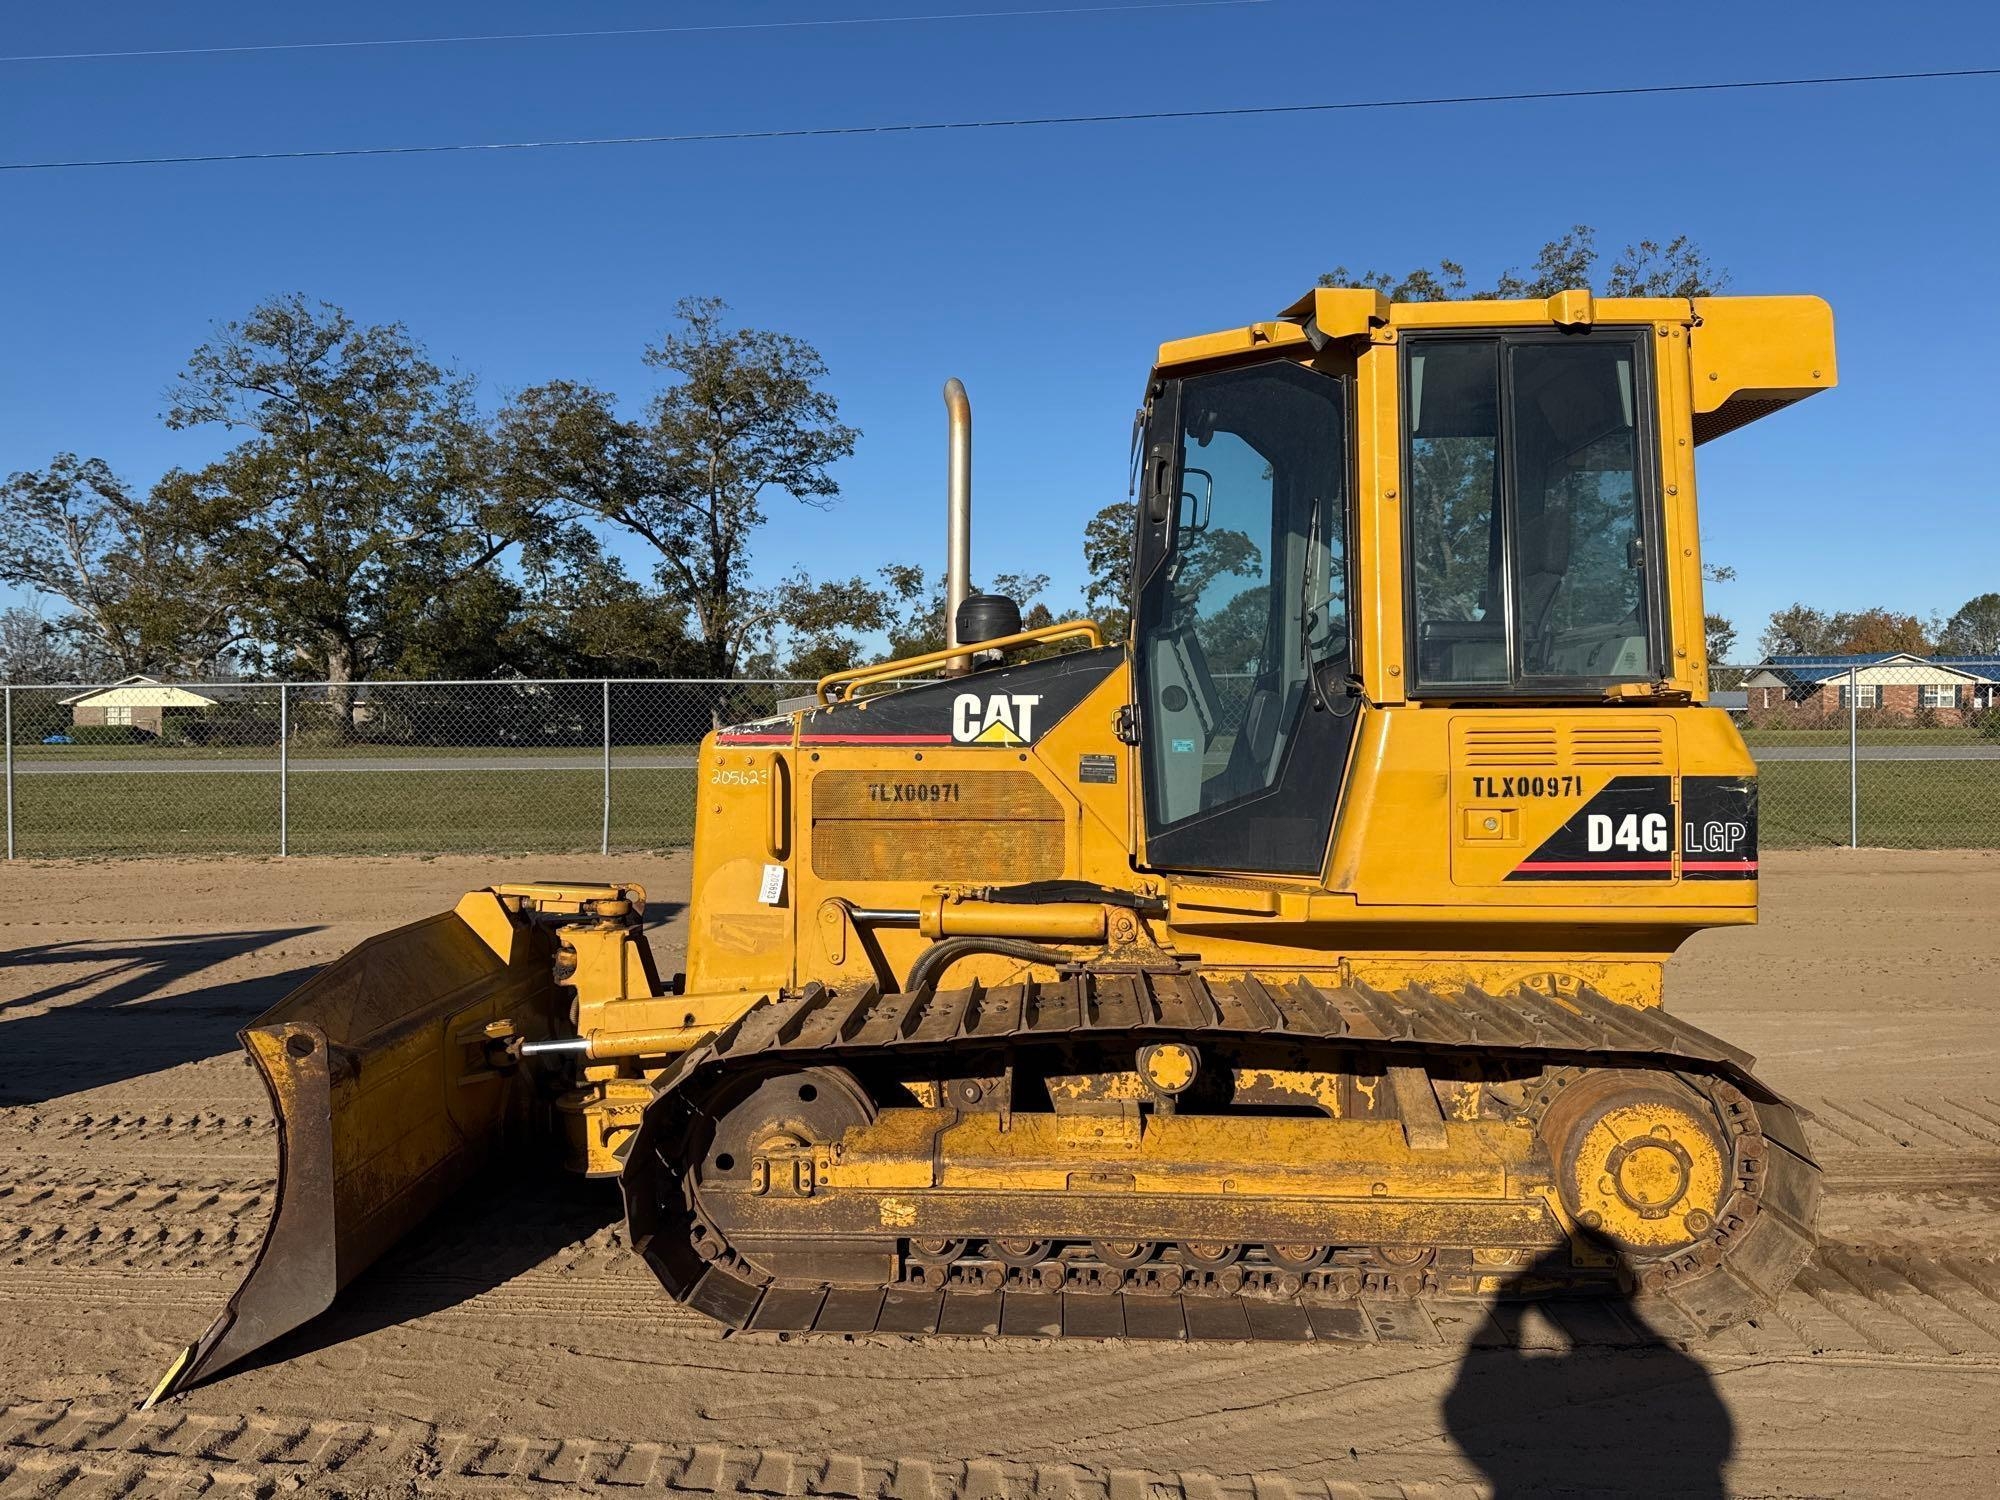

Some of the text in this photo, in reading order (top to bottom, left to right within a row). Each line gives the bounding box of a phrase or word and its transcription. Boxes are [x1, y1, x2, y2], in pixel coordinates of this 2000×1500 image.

[952, 693, 1040, 743] CAT
[1587, 813, 1746, 853] D4G LGP
[766, 873, 780, 899] 205623
